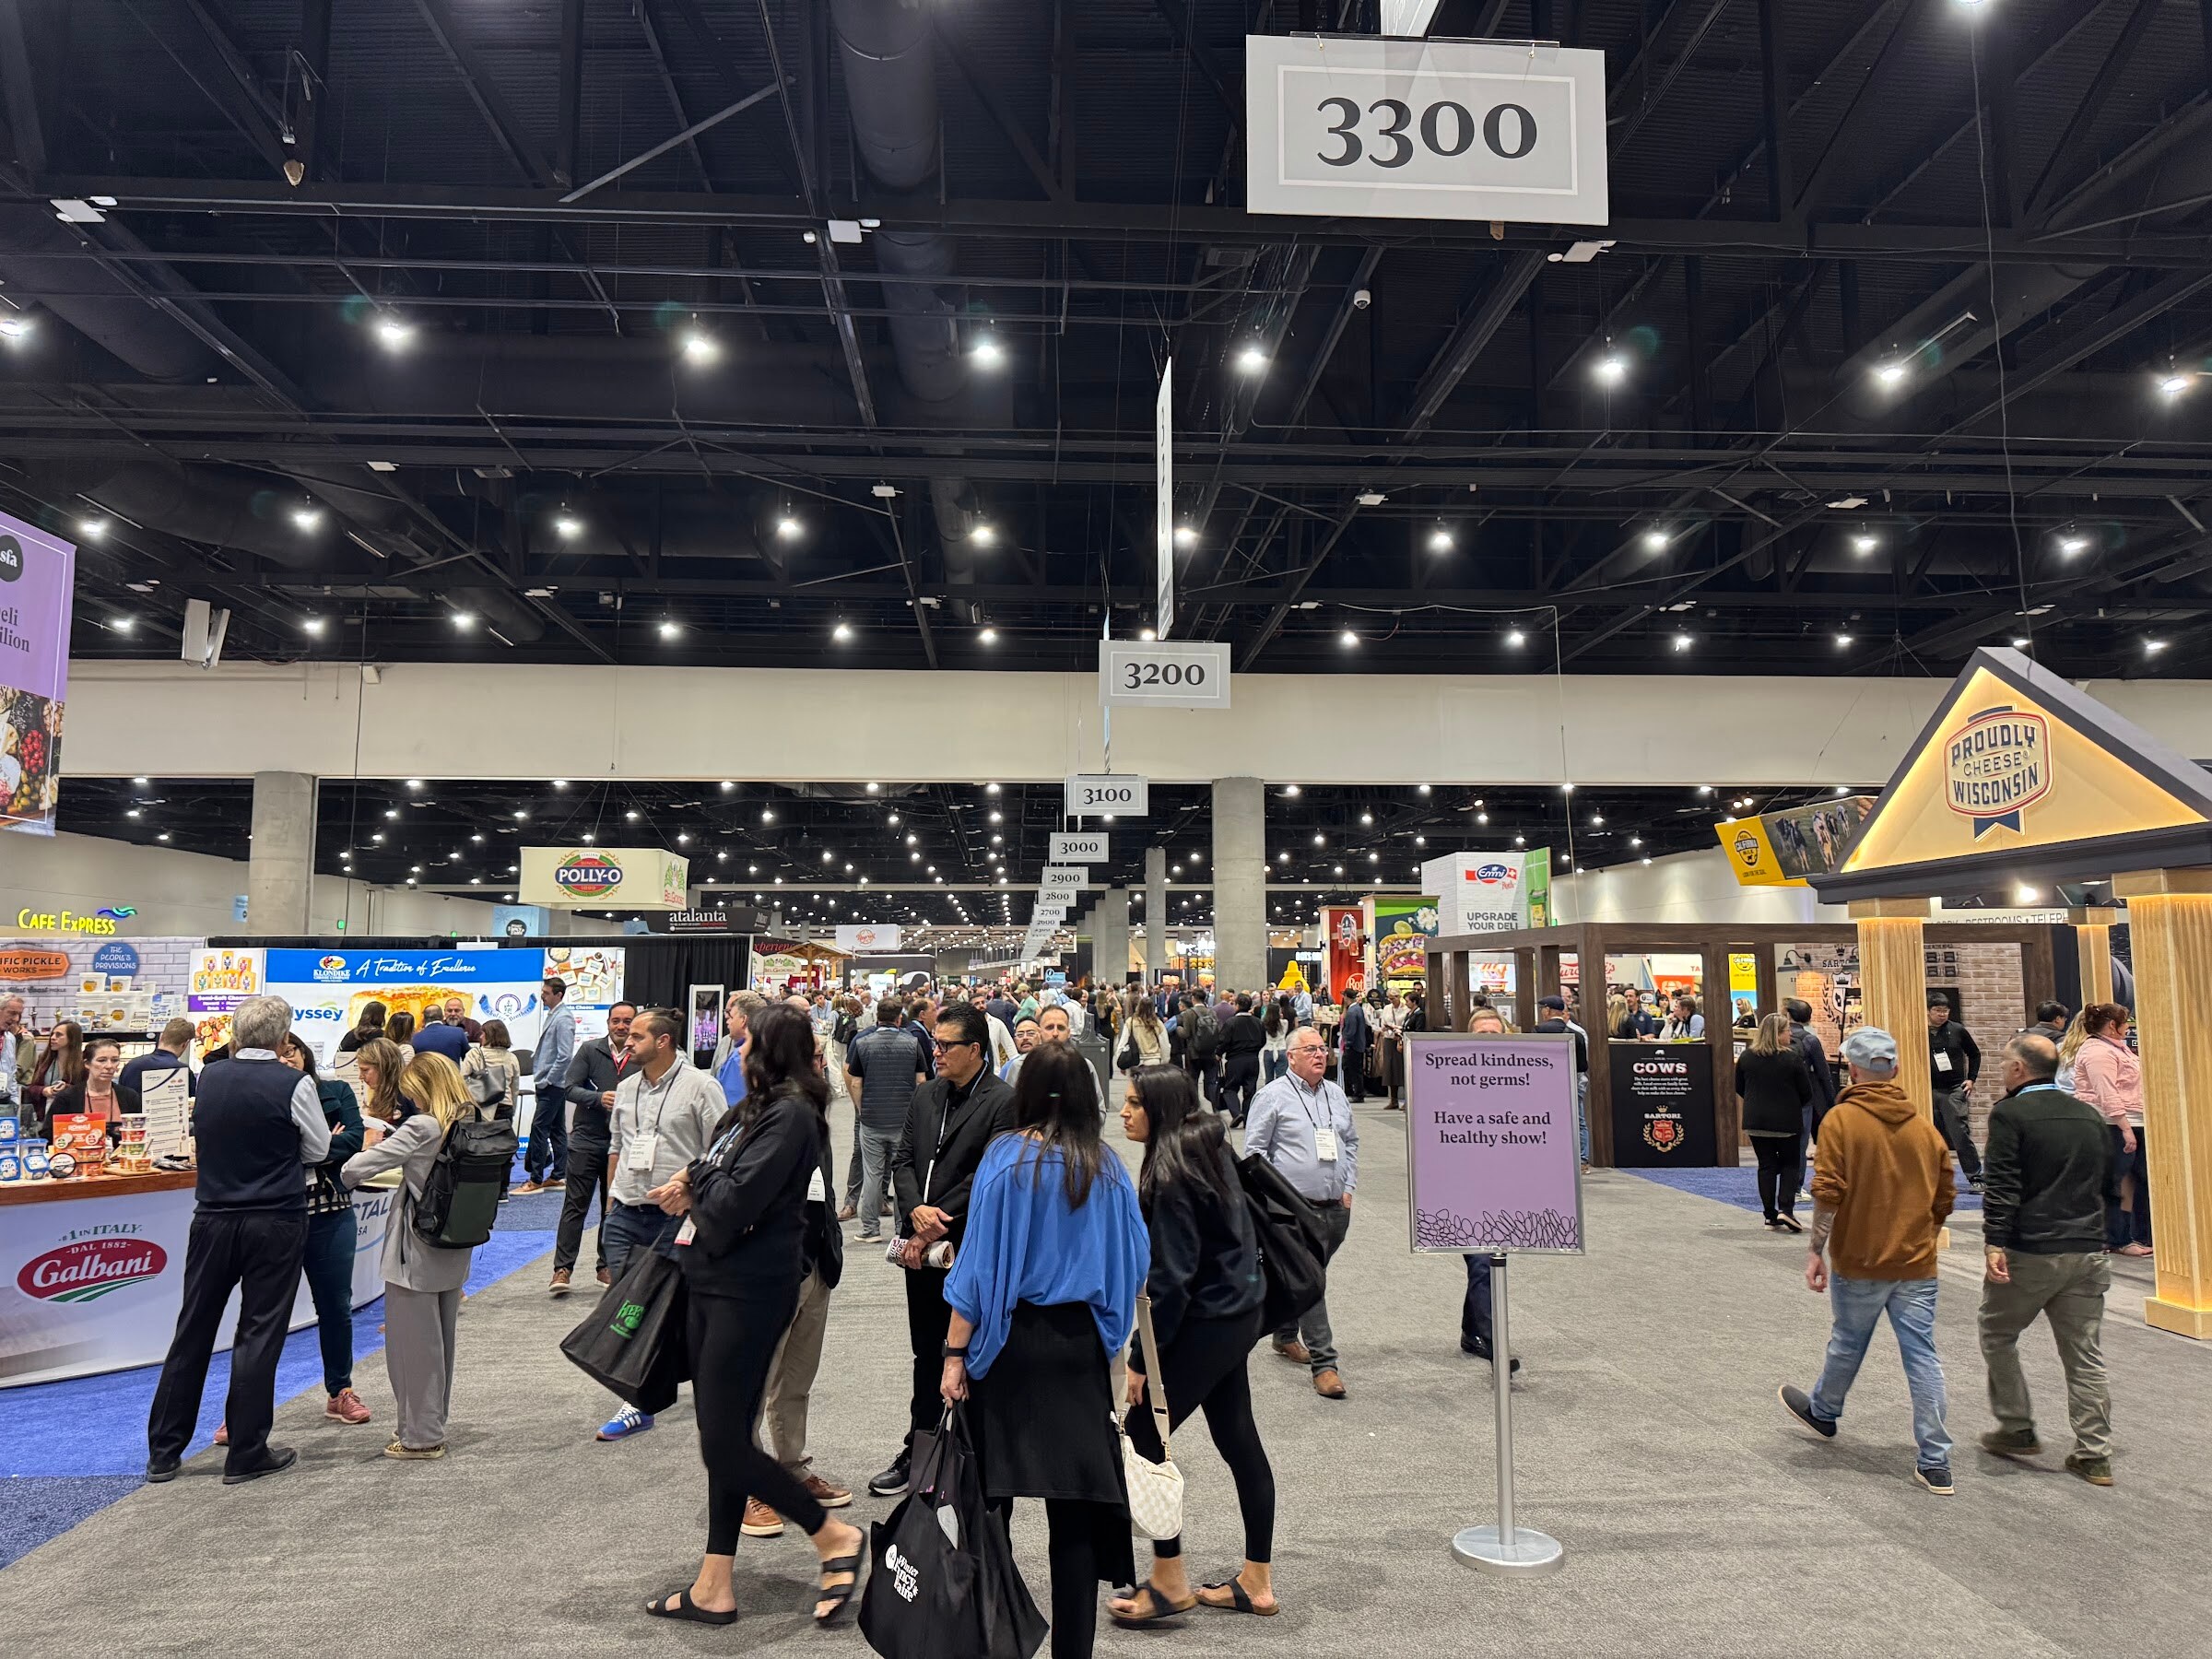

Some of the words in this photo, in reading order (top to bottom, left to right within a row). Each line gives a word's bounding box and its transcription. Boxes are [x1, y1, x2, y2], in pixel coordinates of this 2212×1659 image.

[1317, 97, 1537, 169] 3300
[0, 549, 18, 568] sfa
[1124, 663, 1206, 689] 3200
[1951, 724, 2036, 767] PROUDLY
[1953, 761, 2039, 805] WISCONSIN
[1083, 788, 1132, 805] 3100
[1060, 841, 1099, 854] 3000
[559, 869, 621, 882] POLLY-O
[1051, 874, 1080, 883] 2900
[669, 907, 727, 922] atalanta
[1466, 912, 1518, 921] UPGRADE
[100, 953, 132, 961] PEOPLE'S
[313, 969, 350, 977] KLONDIKE
[356, 959, 371, 978] A
[374, 958, 414, 977] Tradition
[417, 959, 429, 976] of
[429, 957, 477, 977] Excellence
[291, 1006, 343, 1021] yssey
[1425, 1053, 1476, 1068] Spread
[1481, 1053, 1554, 1069] kindness,
[1632, 1063, 1688, 1074] COWS
[1451, 1074, 1476, 1086] not
[1479, 1074, 1530, 1088] germs!
[1434, 1112, 1473, 1124] Have
[1477, 1115, 1485, 1124] a
[1488, 1112, 1519, 1124] safe
[1523, 1112, 1551, 1125] and
[1440, 1131, 1498, 1147] healthy
[1500, 1131, 1547, 1144] show!
[32, 1251, 153, 1288] Galbani
[899, 1554, 919, 1577] Winter
